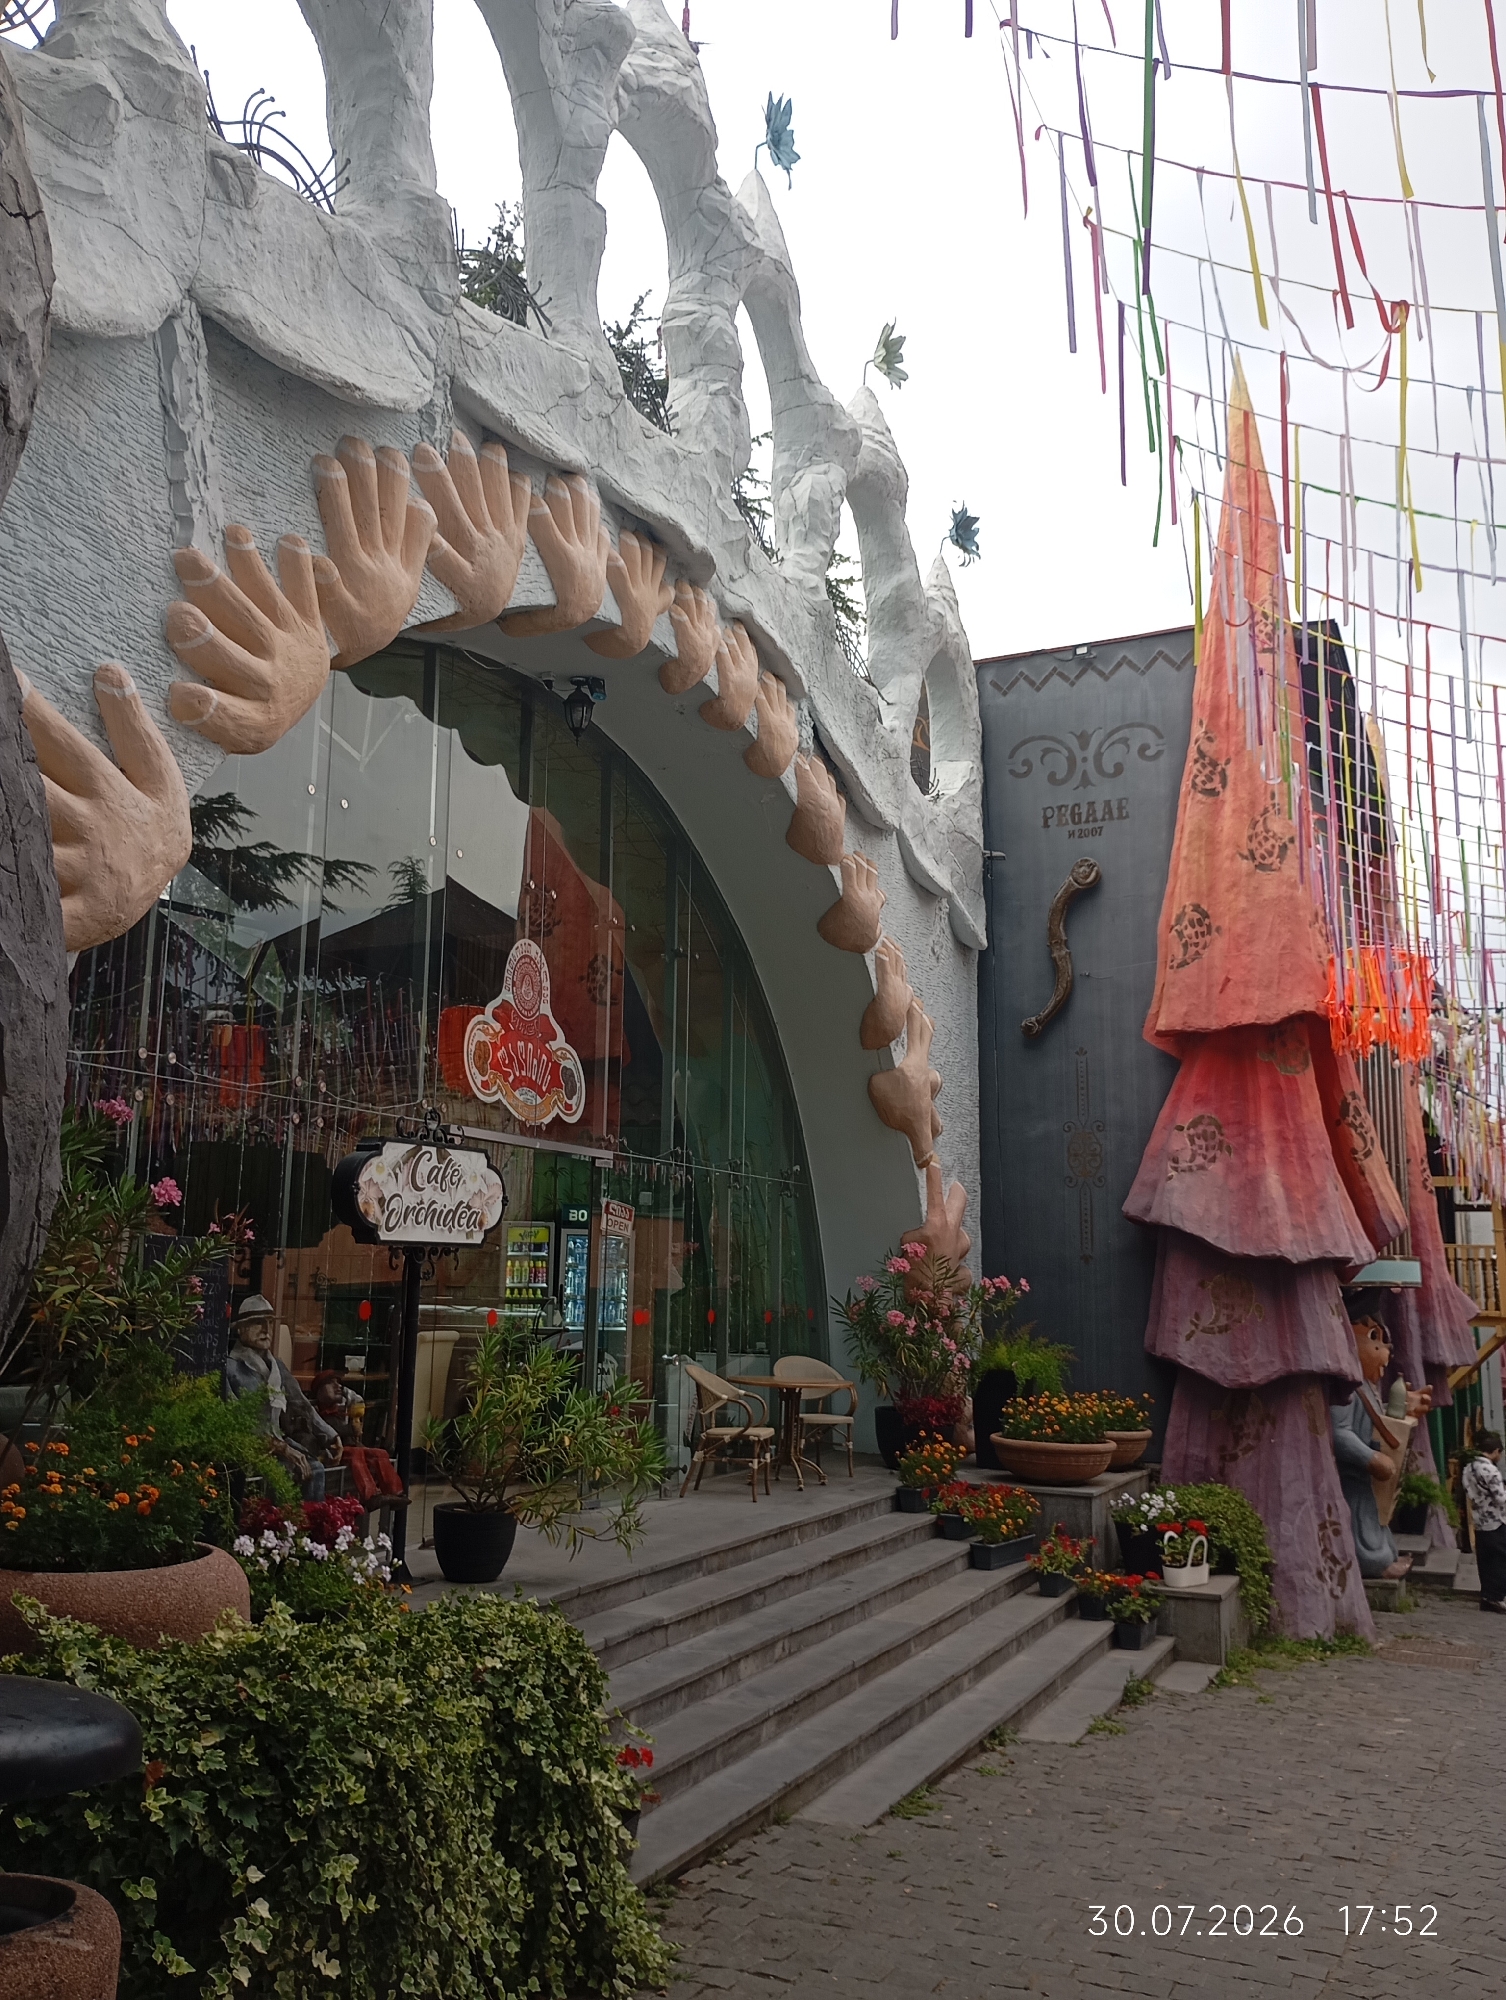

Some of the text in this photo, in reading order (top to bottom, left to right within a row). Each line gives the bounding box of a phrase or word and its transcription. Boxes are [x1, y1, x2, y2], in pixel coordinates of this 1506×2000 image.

[1077, 826, 1104, 839] 2007
[410, 1150, 462, 1193] Café
[607, 1218, 630, 1233] OPEN
